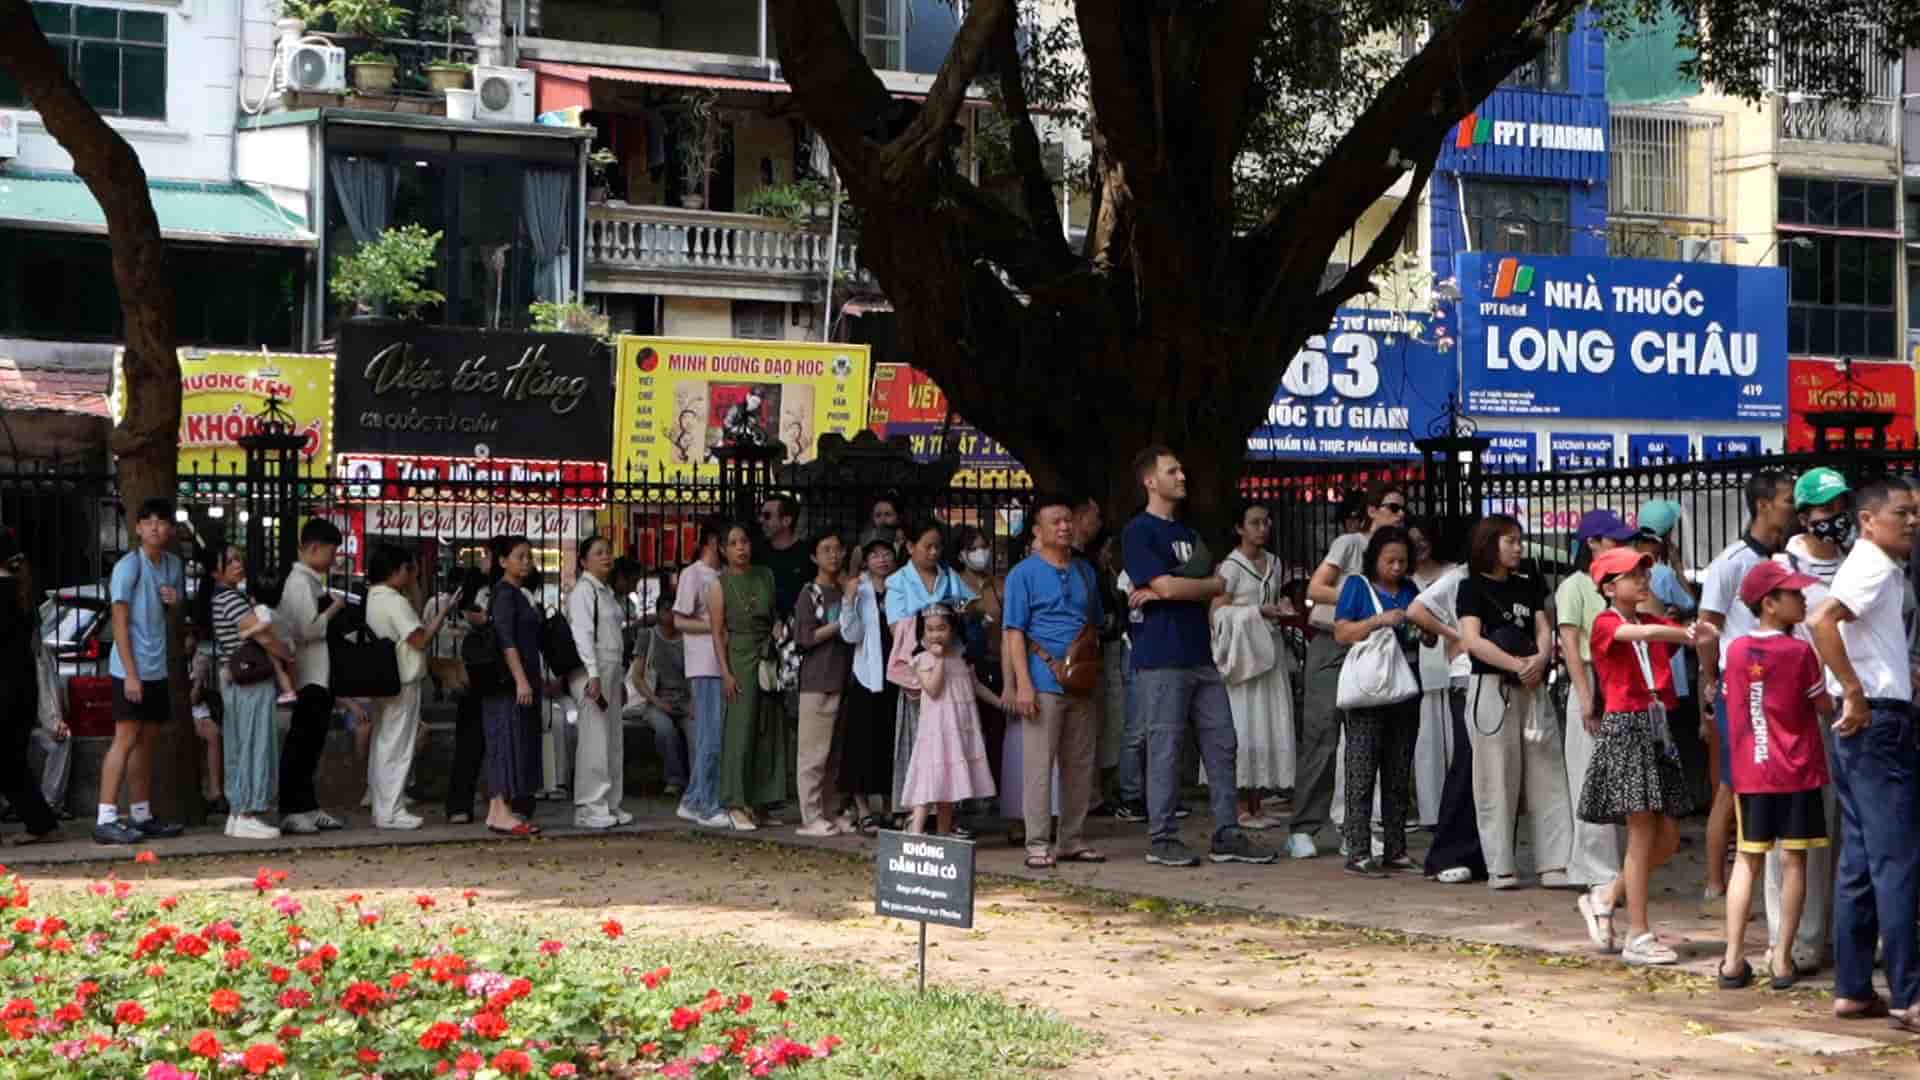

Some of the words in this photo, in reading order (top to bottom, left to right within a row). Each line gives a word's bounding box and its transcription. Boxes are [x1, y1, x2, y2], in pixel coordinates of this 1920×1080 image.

[1494, 120, 1526, 147] FPT
[1529, 124, 1605, 152] PHARMA
[1545, 273, 1603, 311] NHÀ
[1612, 273, 1704, 317] THUỐC
[668, 353, 707, 373] MINH
[1487, 326, 1616, 375] LONG
[1631, 322, 1759, 377] CHÂU
[1281, 333, 1380, 399] 63
[1742, 384, 1762, 396] 419
[1266, 397, 1308, 428] UỐC
[903, 842, 945, 860] KHÔNG
